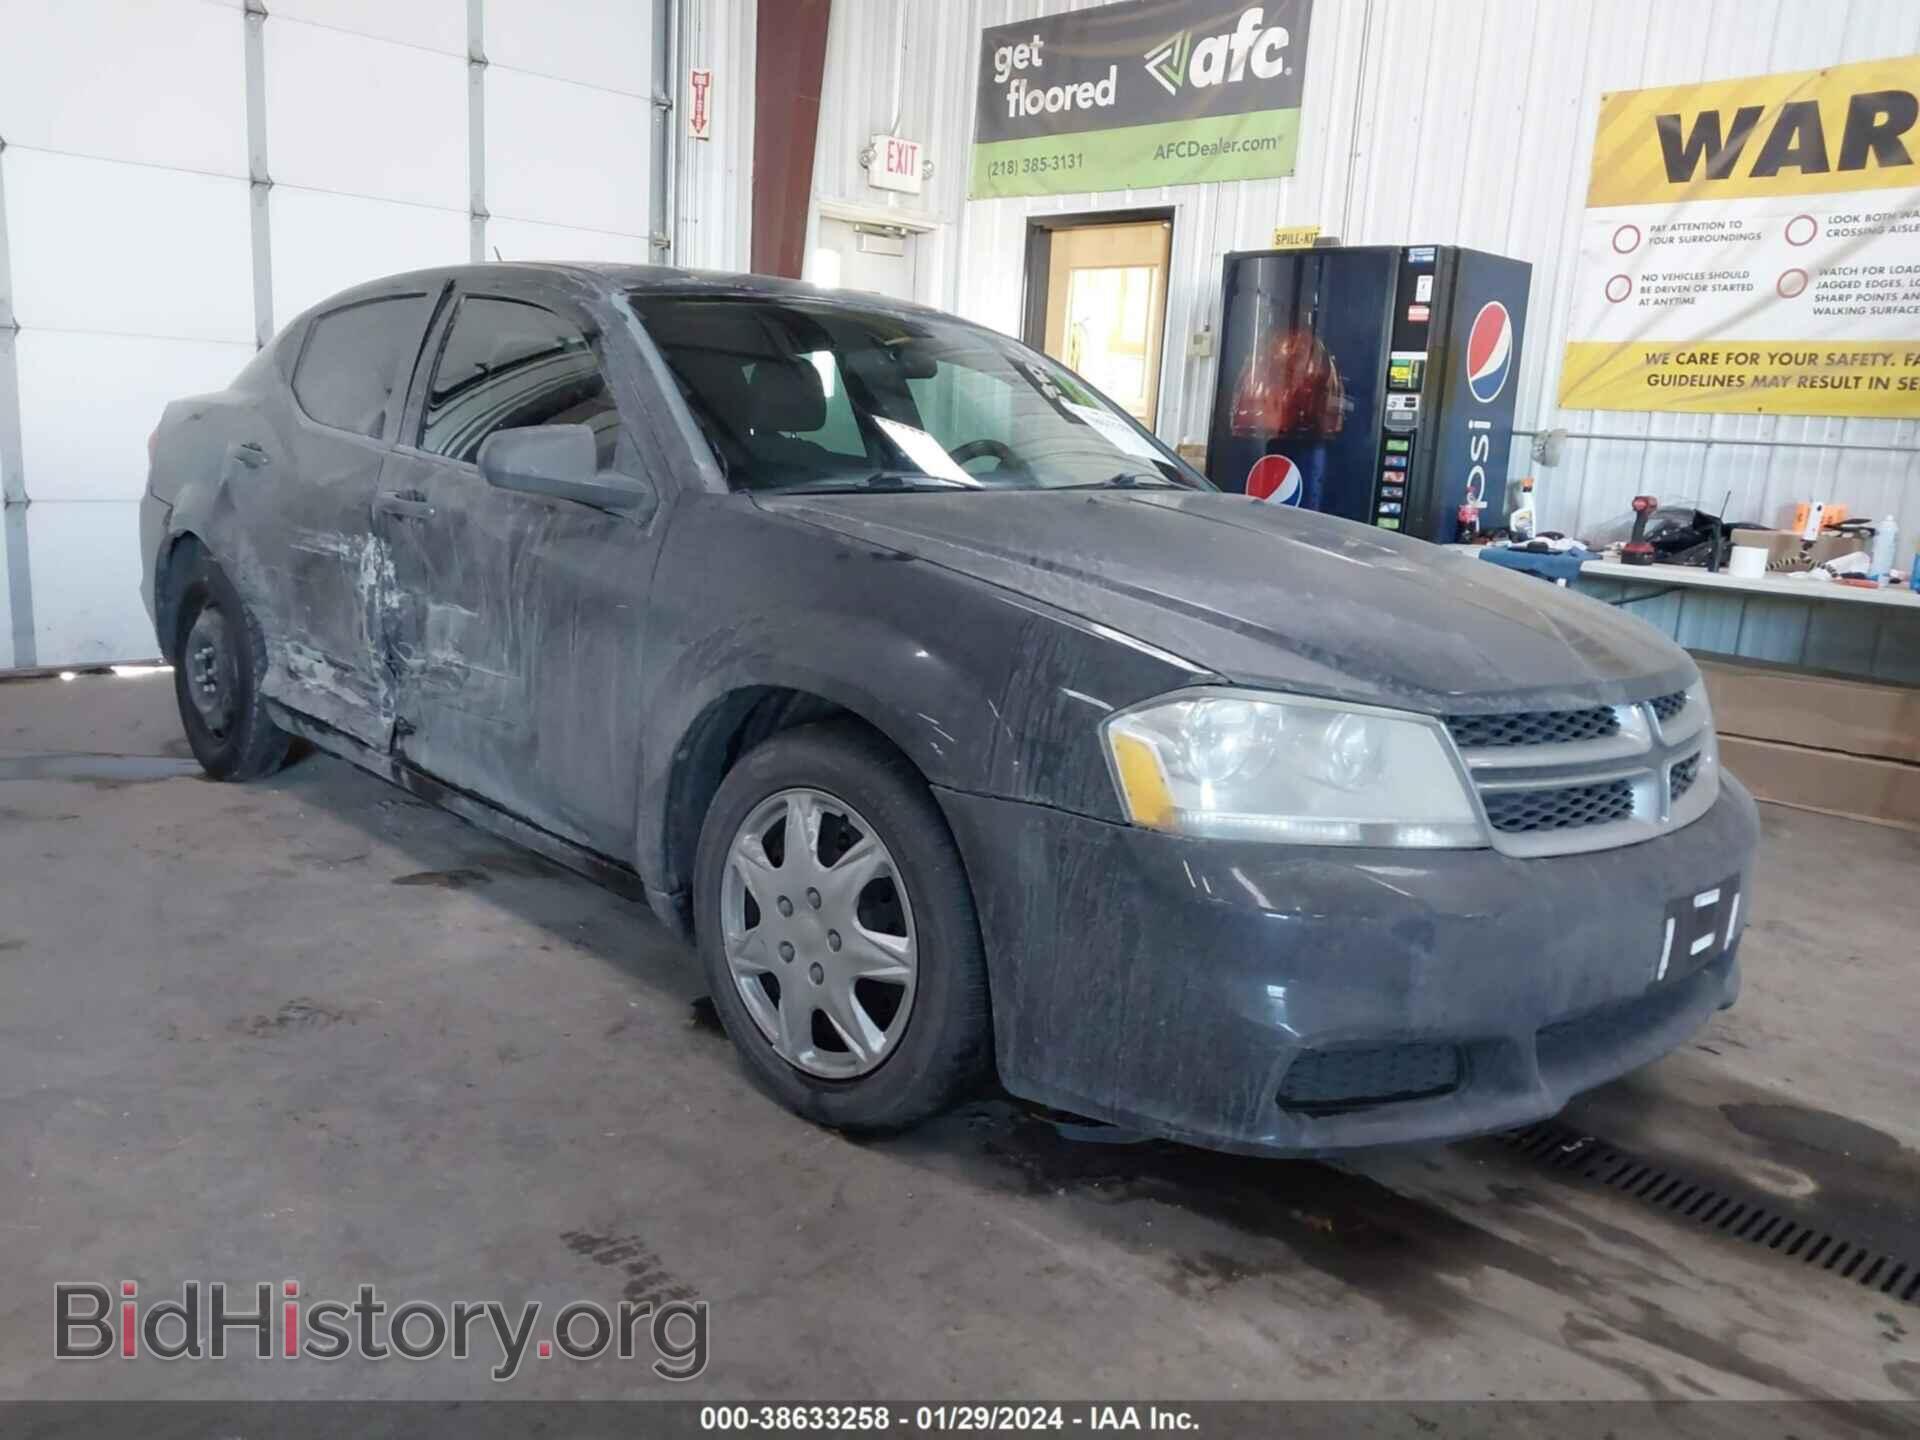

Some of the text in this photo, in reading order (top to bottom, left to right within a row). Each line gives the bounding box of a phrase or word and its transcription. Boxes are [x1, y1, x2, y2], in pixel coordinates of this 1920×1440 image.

[1188, 8, 1289, 88] afc
[994, 35, 1044, 83] get
[1006, 65, 1118, 118] floored
[1655, 90, 1920, 184] WAR
[1153, 136, 1277, 161] AFCDealer.com
[887, 140, 917, 177] EXIT
[987, 153, 1084, 179] (218) 385-3131
[1828, 214, 1860, 225] LOOK
[1864, 211, 1897, 223] BOTH
[1650, 220, 1743, 232] PAY ATTENTION TO
[1826, 226, 1885, 238] CROSSING
[1649, 231, 1762, 246] YOUR SURROUNDINGS
[1642, 270, 1750, 282] NO VEHICLES SHOULD
[1819, 266, 1858, 276] WATCH
[1862, 265, 1885, 275] FOR
[1640, 283, 1754, 294] BE DRIVEN OR STARTED
[1816, 280, 1861, 290] JAGGED
[1653, 297, 1696, 306] ANYTIME
[1815, 293, 1852, 303] SHARP
[1856, 292, 1897, 302] POINTS
[1813, 306, 1866, 316] WALKING
[1645, 353, 1669, 365] WE
[1676, 352, 1719, 366] CARE
[1725, 353, 1760, 366] FOR
[1768, 353, 1818, 366] YOUR
[1825, 352, 1896, 367] SAFETY.
[1647, 373, 1745, 388] GUIDELINES
[1751, 375, 1792, 388] MAY
[1798, 375, 1863, 390] RESULT
[1867, 376, 1890, 390] IN
